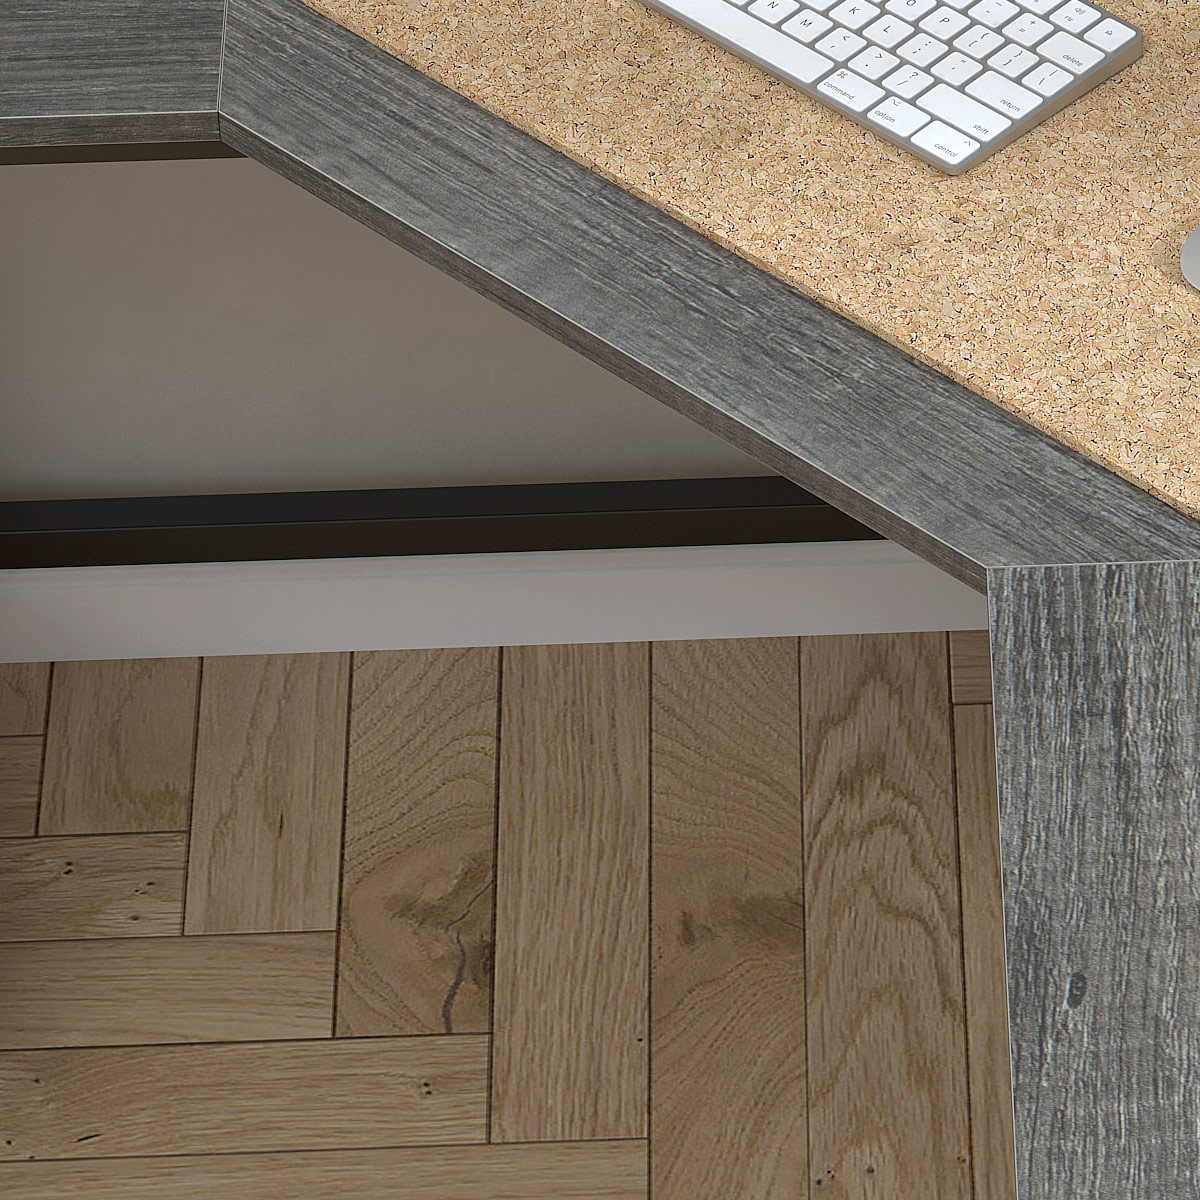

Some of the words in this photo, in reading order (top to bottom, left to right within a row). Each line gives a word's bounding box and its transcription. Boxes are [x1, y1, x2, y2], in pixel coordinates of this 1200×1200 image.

[767, 0, 779, 9] N
[848, 6, 861, 15] K
[799, 18, 813, 28] M
[882, 25, 891, 33] L
[1062, 54, 1083, 67] delete
[823, 81, 856, 100] command
[999, 99, 1021, 112] return
[874, 110, 896, 123] option
[972, 124, 990, 135] shift
[934, 143, 959, 158] control
